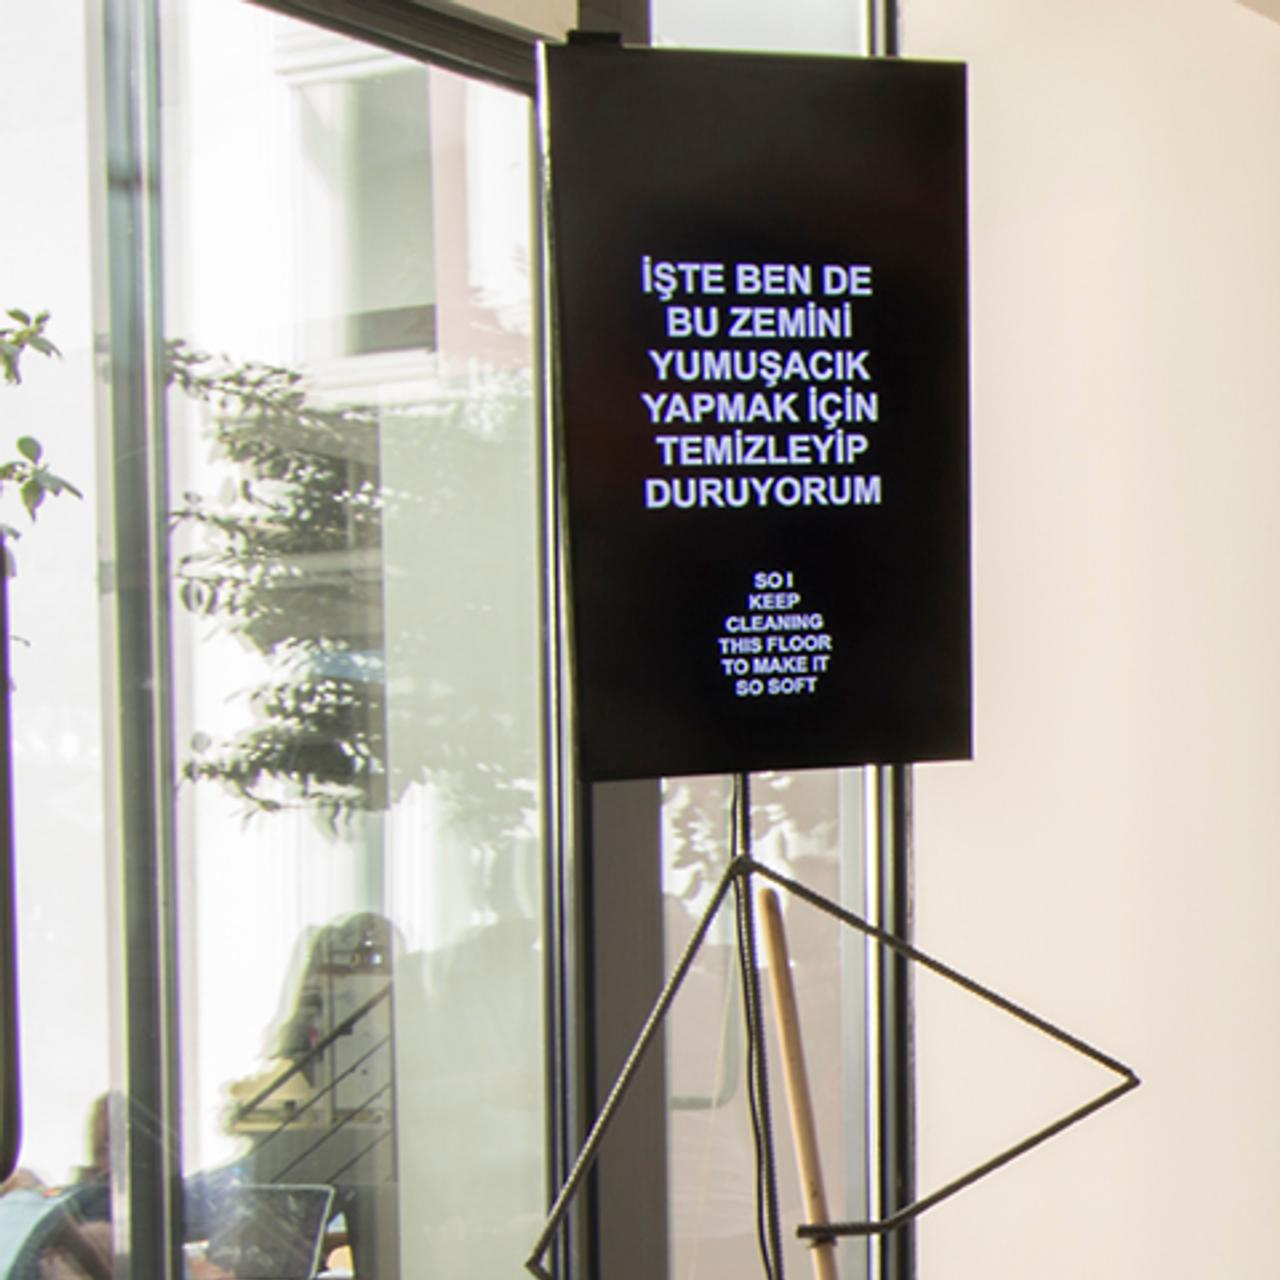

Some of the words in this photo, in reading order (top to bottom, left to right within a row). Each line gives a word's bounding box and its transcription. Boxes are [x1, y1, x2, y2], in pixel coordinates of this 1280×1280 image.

[642, 255, 726, 302] İŞTE
[736, 264, 812, 295] BEN
[823, 265, 873, 296] DE
[667, 306, 719, 338] BU
[729, 301, 852, 338] ZEMİNİ
[649, 350, 871, 388] YUMUŞACIK
[642, 393, 800, 423] YAPMAK
[809, 386, 879, 430] İÇİN
[655, 428, 869, 466] TEMİZLEYİP
[646, 475, 882, 509] DURUYORUM
[754, 571, 783, 589] SO
[786, 571, 794, 589] I
[748, 592, 801, 610] KEEP
[725, 613, 824, 633] CLEANING
[718, 637, 763, 654] THIS
[767, 634, 832, 653] FLOOR
[721, 658, 750, 675] TO
[752, 656, 808, 674] MAKE
[812, 655, 830, 672] IT
[735, 679, 764, 696] SO
[767, 676, 818, 695] SOFT
